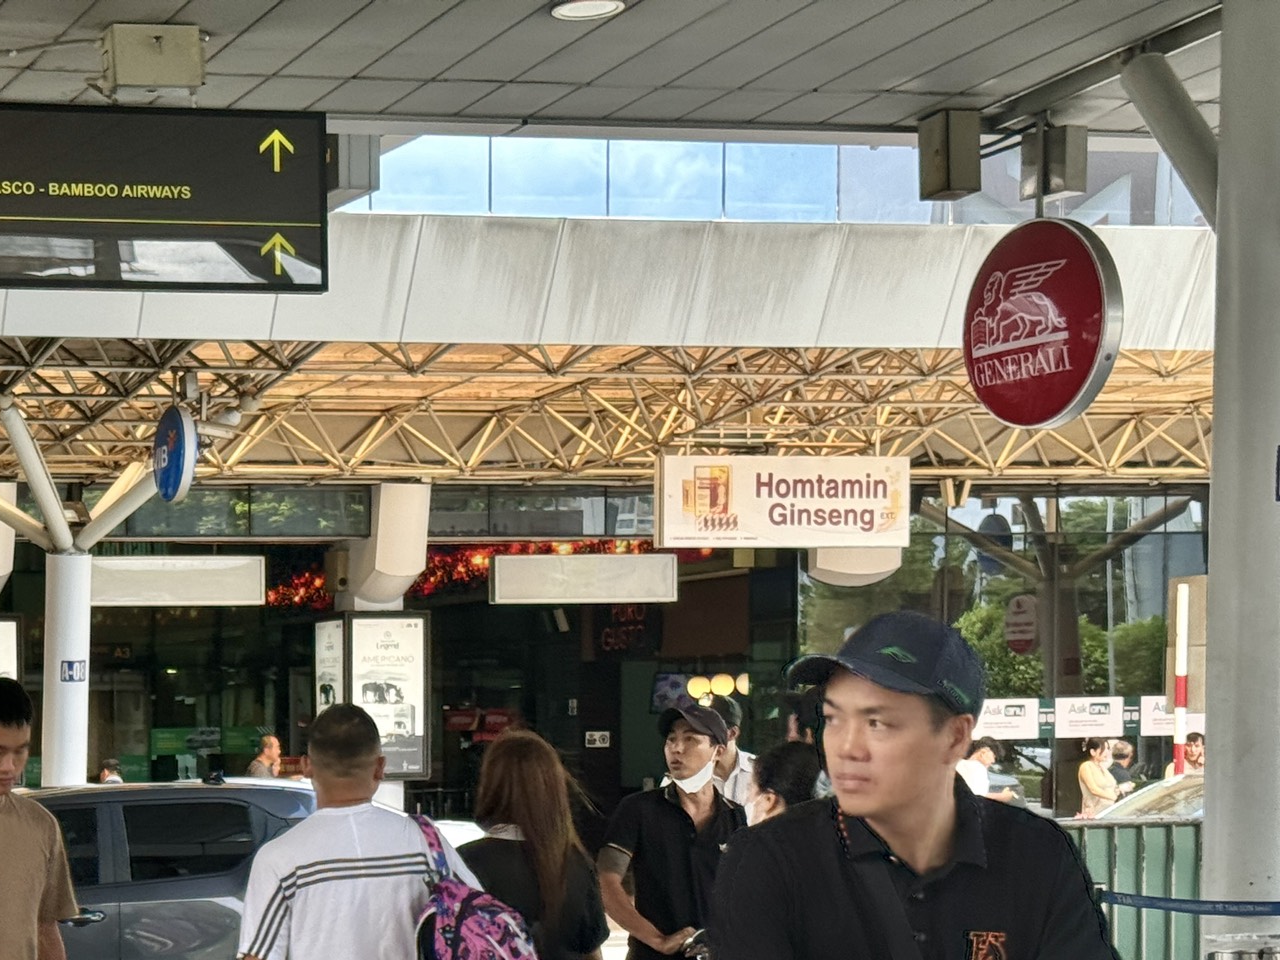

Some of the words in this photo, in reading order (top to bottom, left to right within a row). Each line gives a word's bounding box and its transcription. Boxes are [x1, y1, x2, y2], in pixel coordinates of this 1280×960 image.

[48, 182, 119, 198] BAMBOO
[121, 184, 191, 200] AIRWAYS
[974, 346, 1072, 388] GENERALI
[755, 472, 887, 499] Homtamin
[769, 503, 875, 532] Ginseng
[361, 655, 415, 664] AMERICANO
[1068, 703, 1087, 714] Ask
[1152, 702, 1166, 713] As
